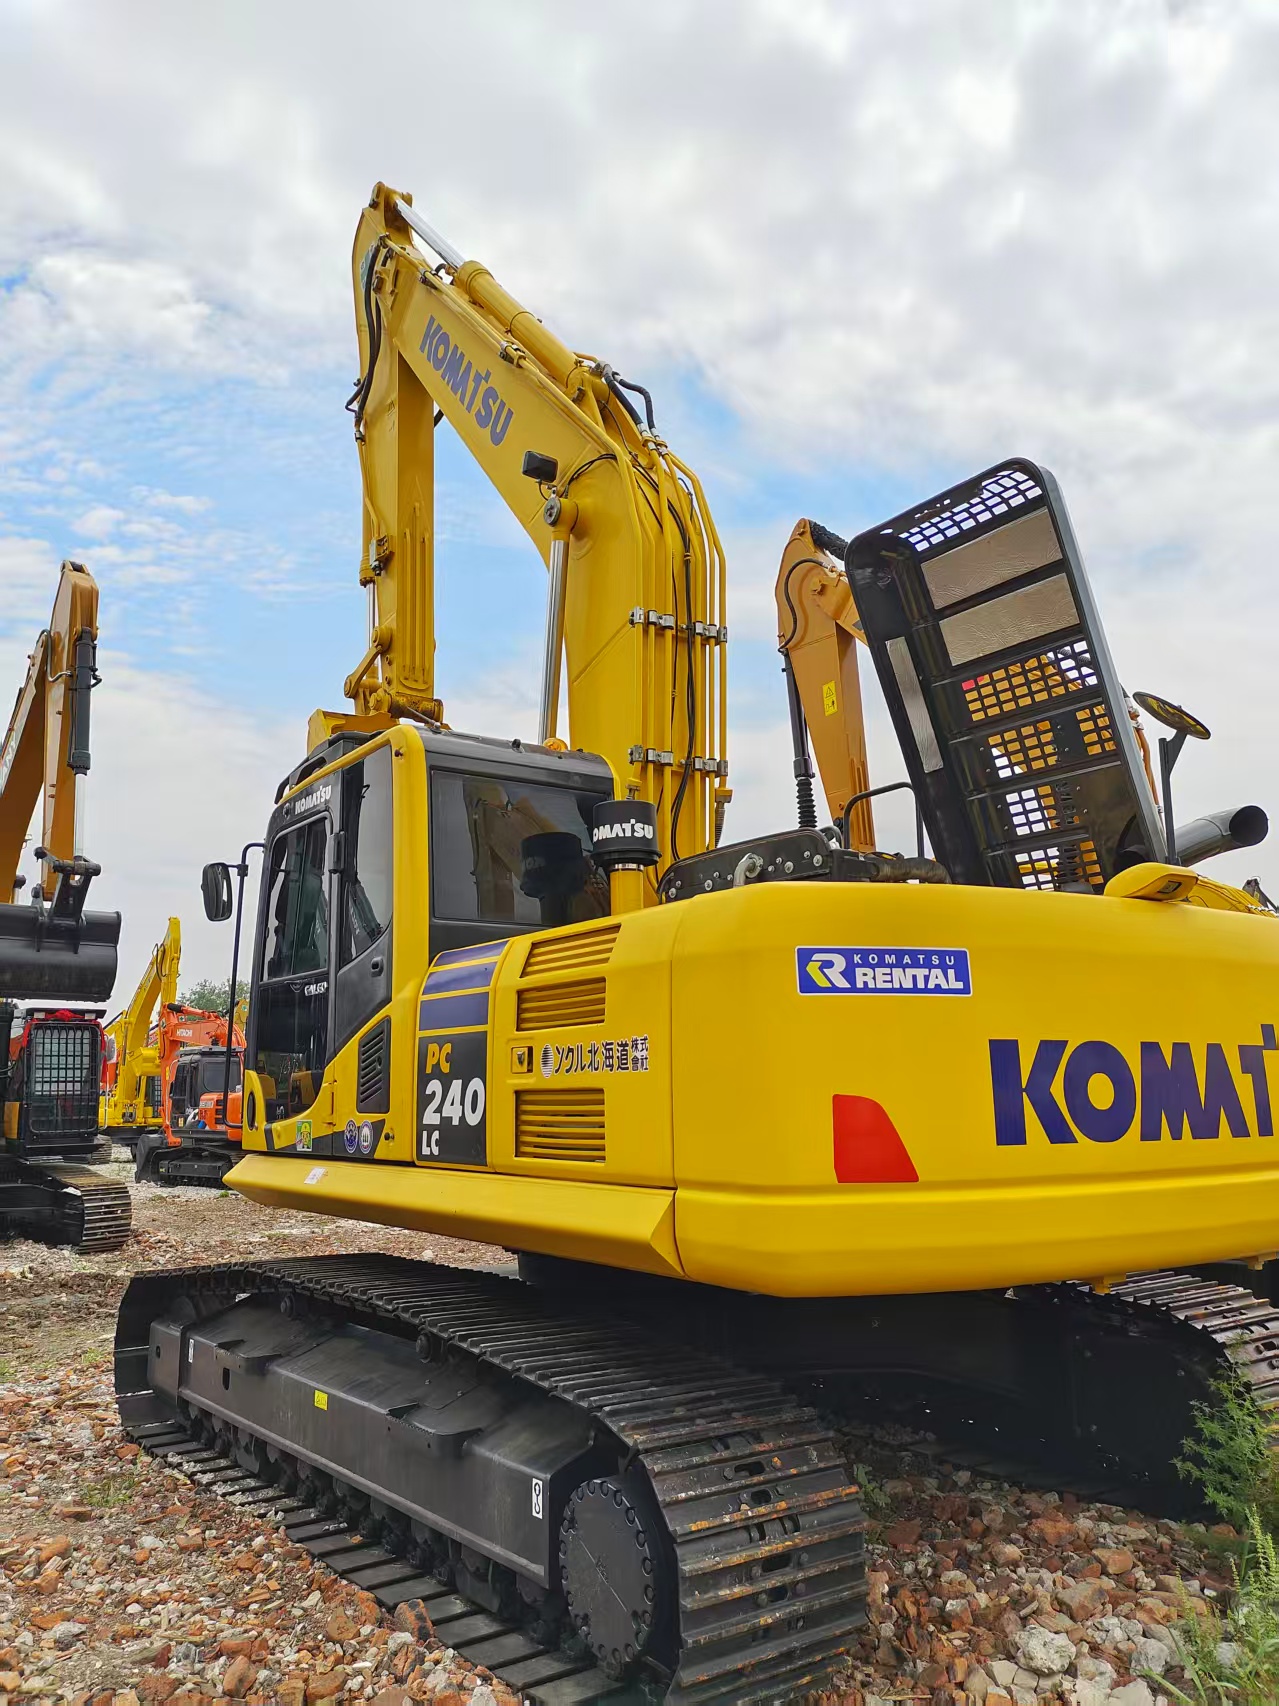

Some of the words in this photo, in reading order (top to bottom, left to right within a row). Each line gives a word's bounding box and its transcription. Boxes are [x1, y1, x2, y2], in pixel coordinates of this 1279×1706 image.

[419, 314, 514, 447] KOMATSU
[295, 785, 332, 815] KOMATSU
[853, 954, 955, 966] KOMATSU
[854, 967, 964, 989] RENTAL
[425, 1043, 452, 1074] PC
[422, 1077, 486, 1127] 240
[421, 1130, 440, 1156] LC
